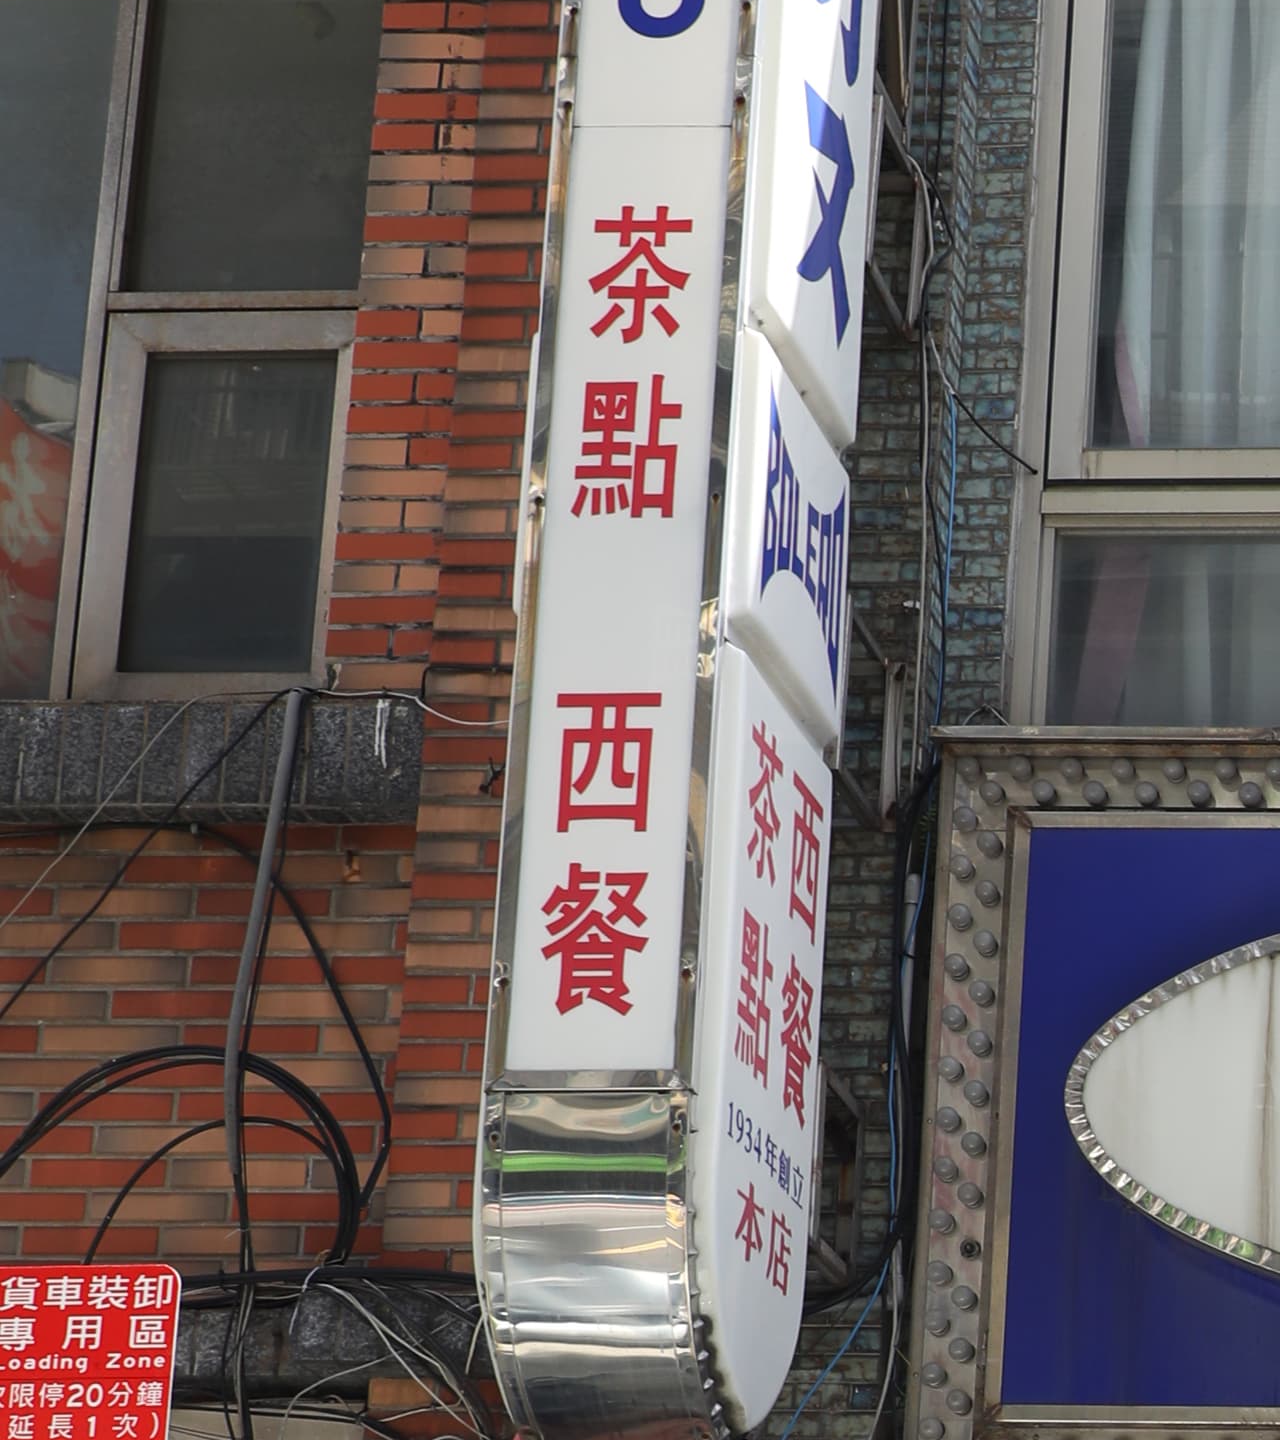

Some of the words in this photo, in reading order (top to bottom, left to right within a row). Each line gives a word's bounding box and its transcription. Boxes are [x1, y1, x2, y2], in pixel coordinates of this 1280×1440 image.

[571, 205, 693, 517] 茶點
[761, 372, 845, 708] BOLERO
[541, 692, 662, 1015] 西餐
[734, 720, 783, 1089] 茶點
[780, 770, 823, 1130] 西餐
[0, 1315, 169, 1351] 專用區
[1, 1274, 174, 1311] 貨車裝卸
[105, 1353, 166, 1369] Zone
[735, 1182, 792, 1296] 本店
